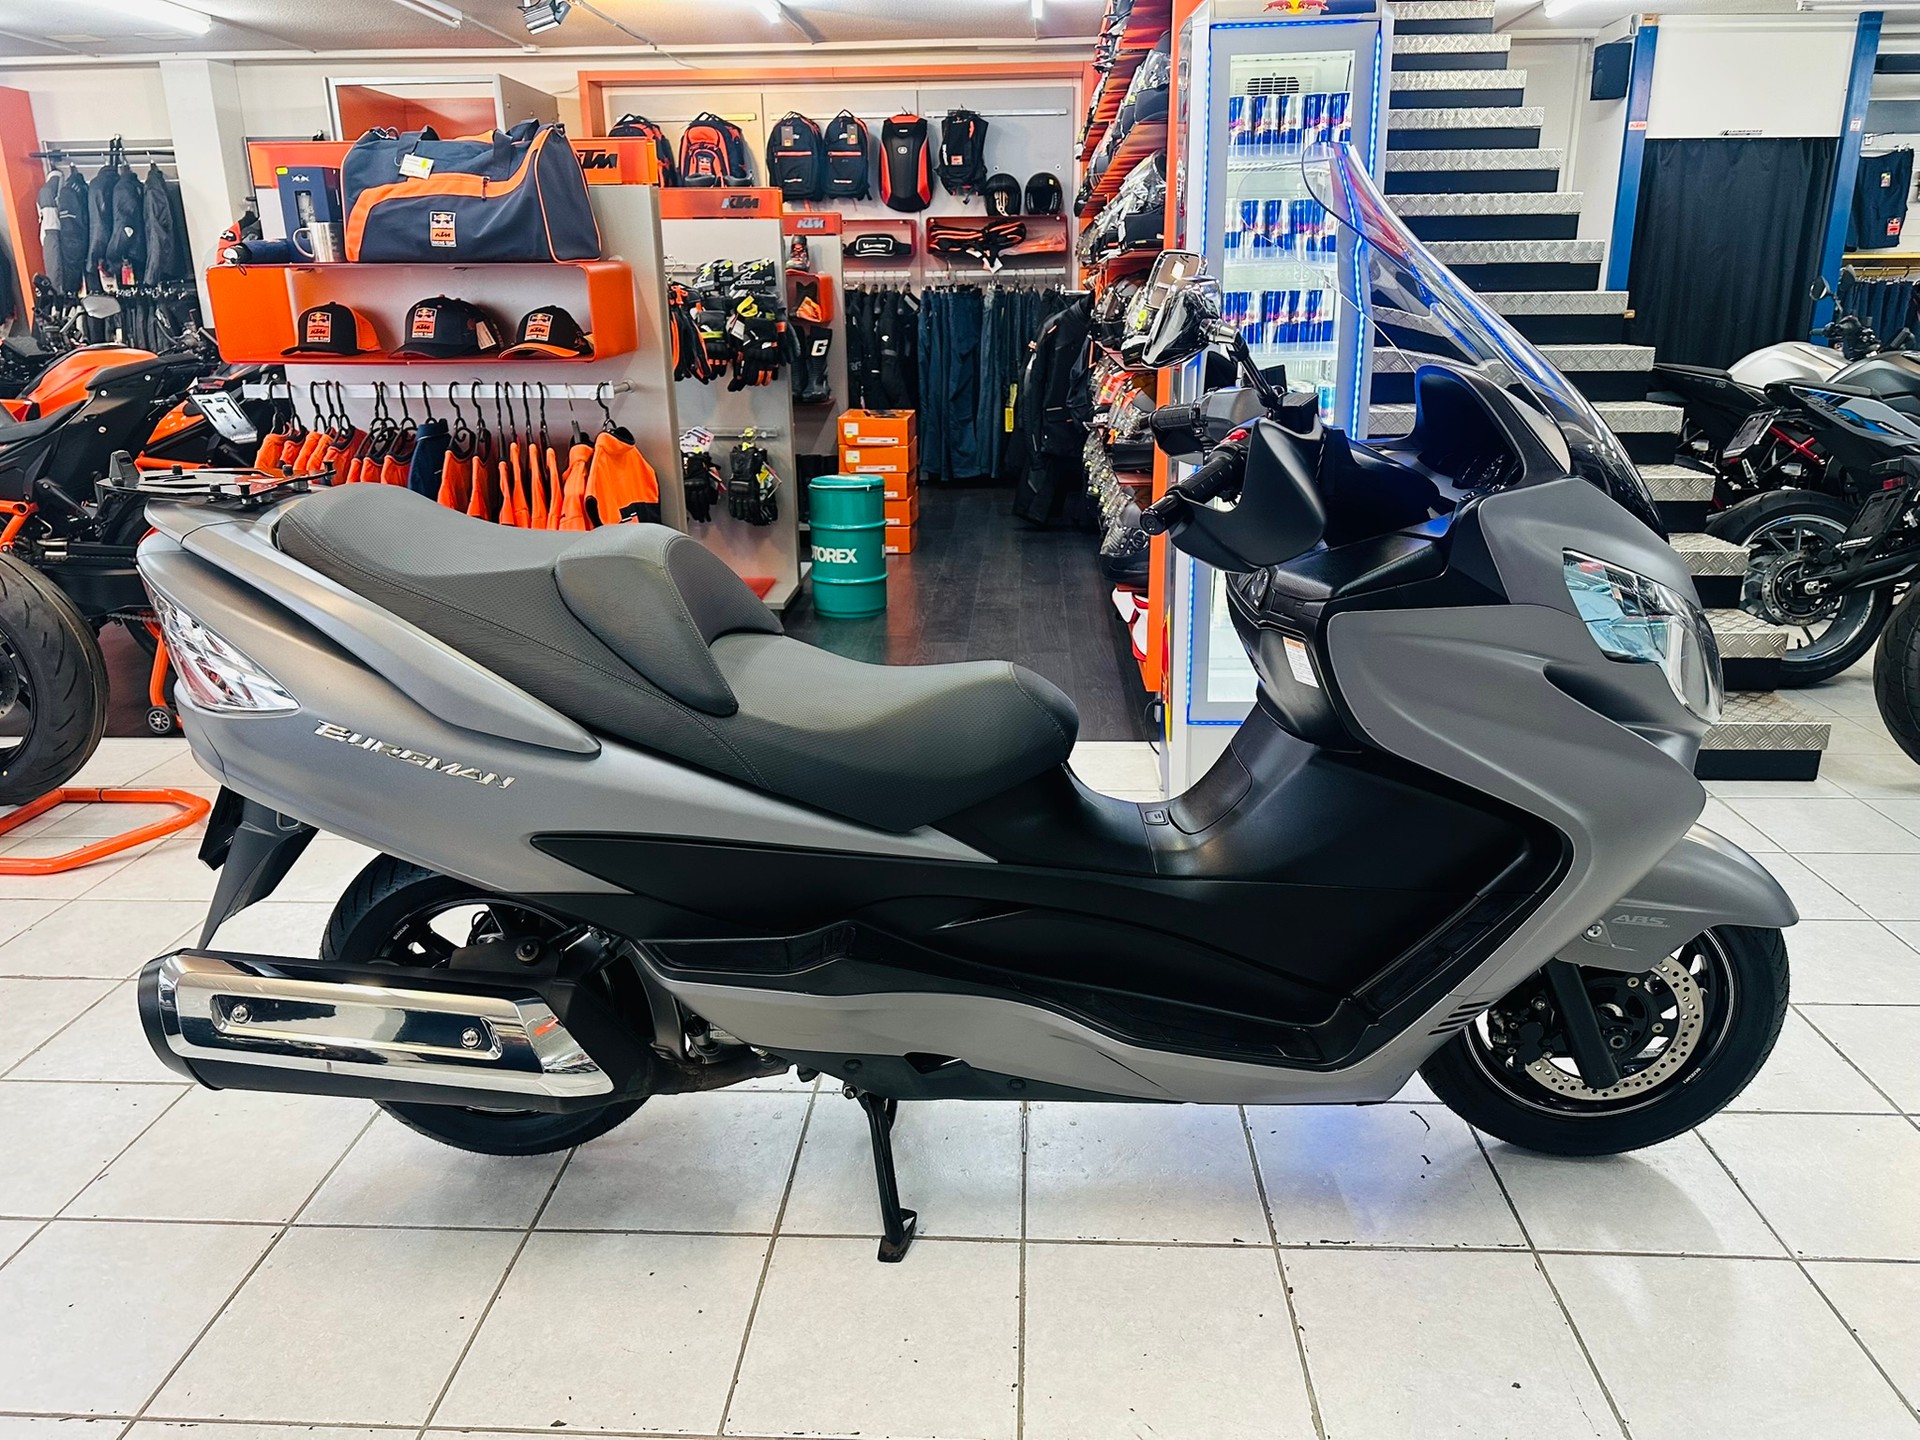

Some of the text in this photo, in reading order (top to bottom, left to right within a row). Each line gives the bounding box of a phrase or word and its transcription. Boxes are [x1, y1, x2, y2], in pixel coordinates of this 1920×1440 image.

[721, 194, 760, 209] KTM
[796, 217, 825, 229] KTM
[811, 338, 829, 357] G
[811, 544, 858, 564] TOREX
[314, 719, 516, 790] BURGMAN
[1611, 914, 1667, 927] ABS
[392, 923, 410, 941] SUZUKI
